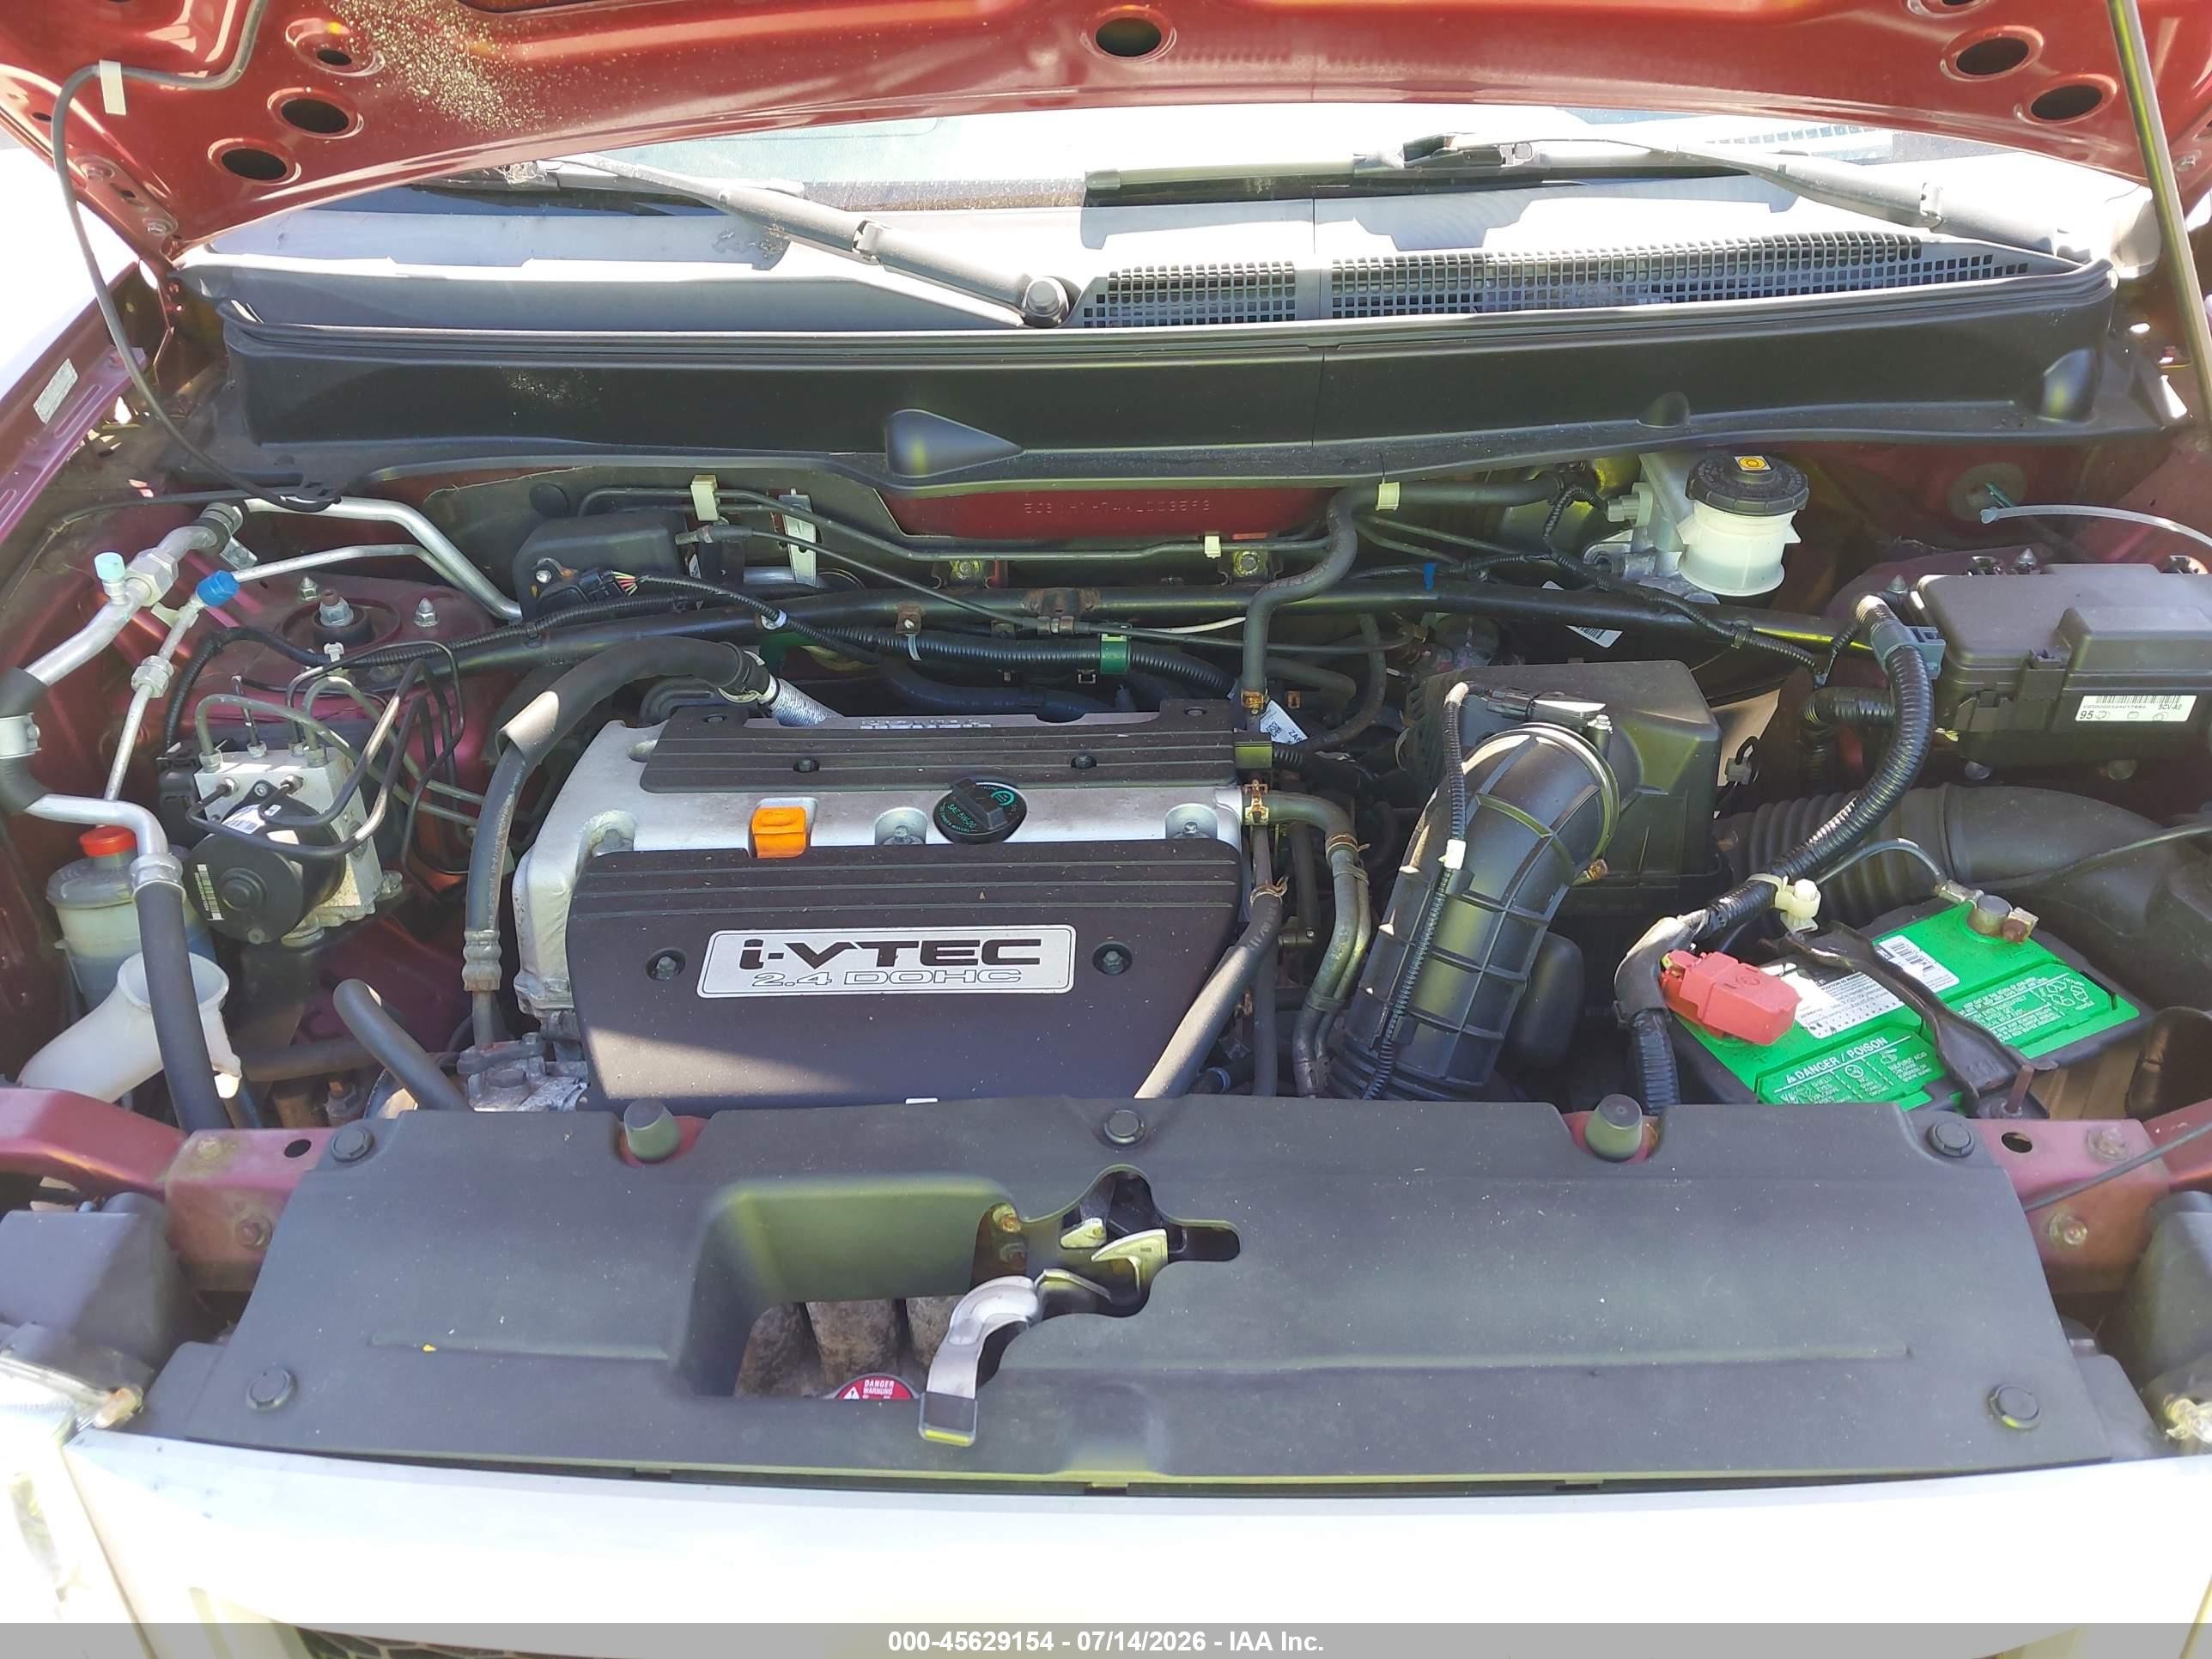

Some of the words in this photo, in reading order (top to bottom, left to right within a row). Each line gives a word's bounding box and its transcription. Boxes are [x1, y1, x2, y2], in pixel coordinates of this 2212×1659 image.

[738, 939, 1042, 970] i-VTEC
[751, 970, 833, 988] 2.4
[844, 969, 1022, 985] DOHC
[1794, 1055, 1841, 1081] DANGER
[1847, 1036, 1888, 1059] POISON
[864, 1379, 895, 1388] DANGER
